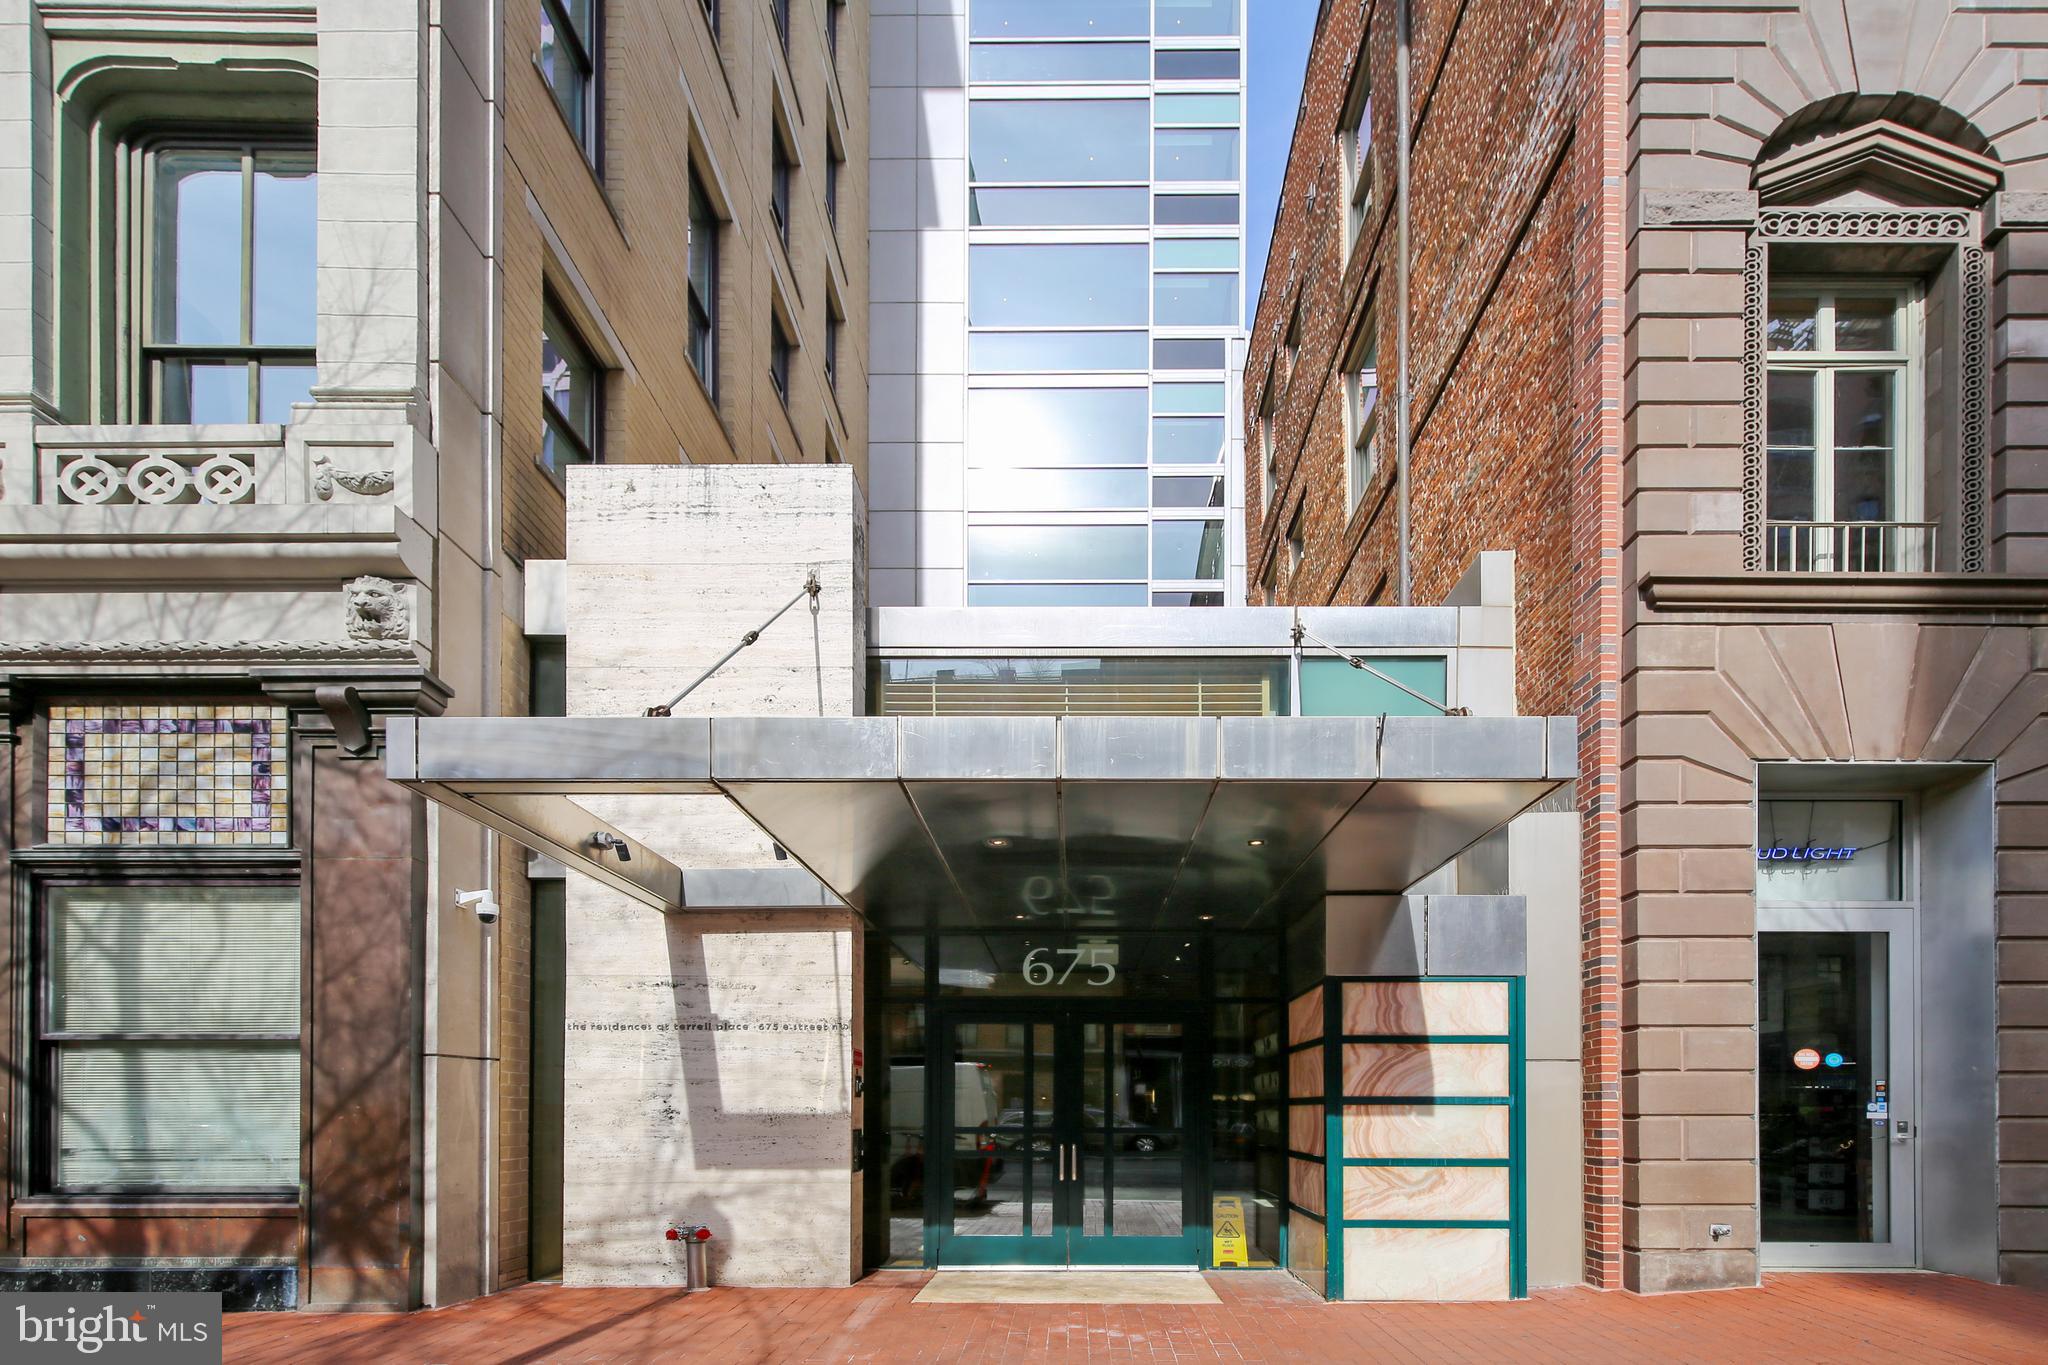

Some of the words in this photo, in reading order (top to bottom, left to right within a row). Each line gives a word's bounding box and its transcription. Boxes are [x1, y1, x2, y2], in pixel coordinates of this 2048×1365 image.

[1757, 847, 1788, 860] UD
[1792, 847, 1857, 860] LIGHT
[1022, 947, 1116, 986] 675
[567, 1022, 587, 1031] the
[590, 1023, 653, 1032] residences
[673, 1022, 712, 1031] terrell
[716, 1022, 749, 1032] place
[758, 1023, 779, 1031] 675
[793, 1023, 828, 1031] street
